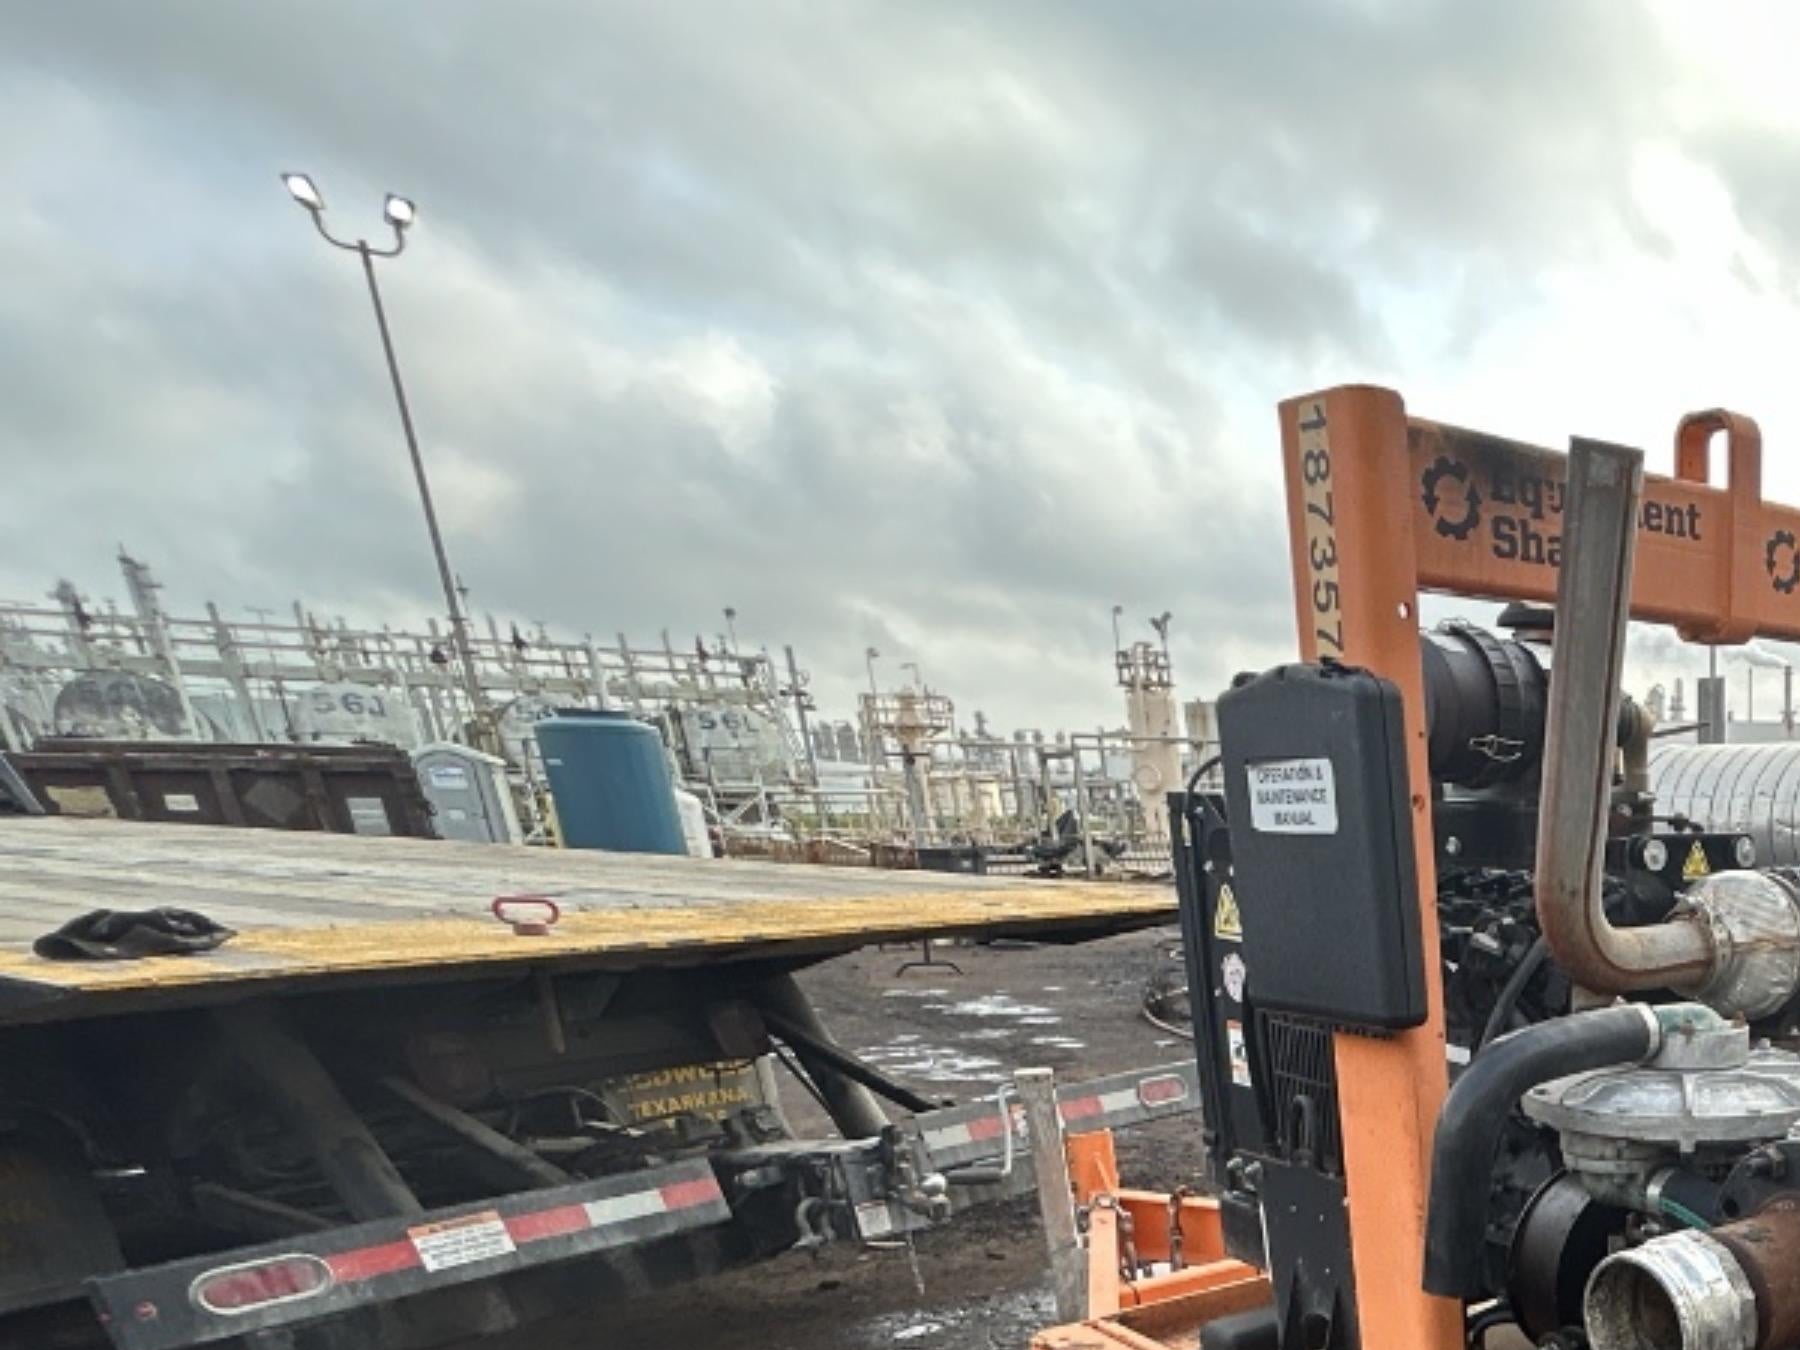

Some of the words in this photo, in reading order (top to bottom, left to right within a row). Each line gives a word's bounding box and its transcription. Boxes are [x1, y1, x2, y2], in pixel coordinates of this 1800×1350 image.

[1300, 404, 1344, 651] 187357
[1488, 455, 1702, 541] Equent
[1490, 515, 1563, 568] Sha
[1273, 810, 1317, 826] MANUAL
